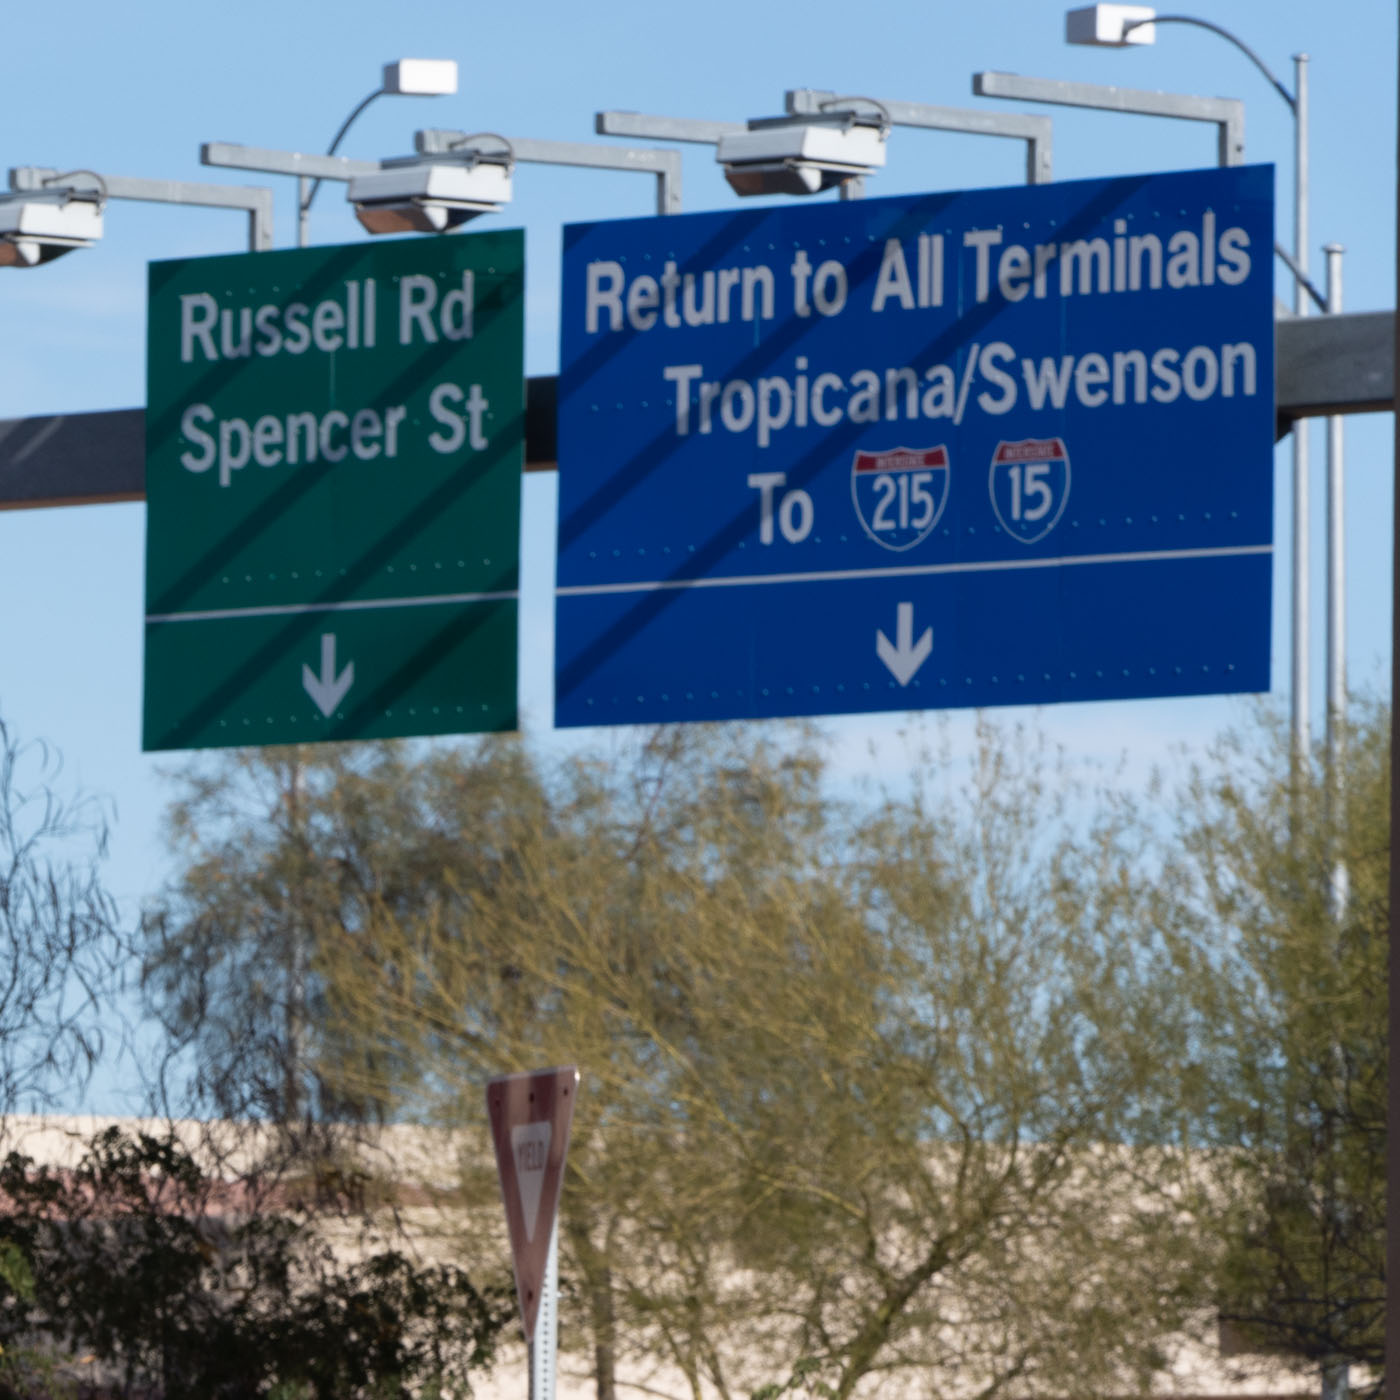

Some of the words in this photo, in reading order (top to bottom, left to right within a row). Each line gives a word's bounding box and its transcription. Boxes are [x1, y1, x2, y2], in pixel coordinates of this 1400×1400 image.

[179, 276, 376, 363] Russell
[399, 269, 475, 345] Rd
[585, 261, 775, 334] Return
[791, 250, 848, 317] to
[871, 234, 944, 312] All
[963, 211, 1252, 303] Terminals
[179, 403, 406, 487] Spencer
[428, 382, 490, 454] St
[663, 341, 1257, 448] Tropicana/Swenson
[747, 472, 814, 545] To
[871, 471, 935, 532] 215
[1008, 463, 1054, 521] 15
